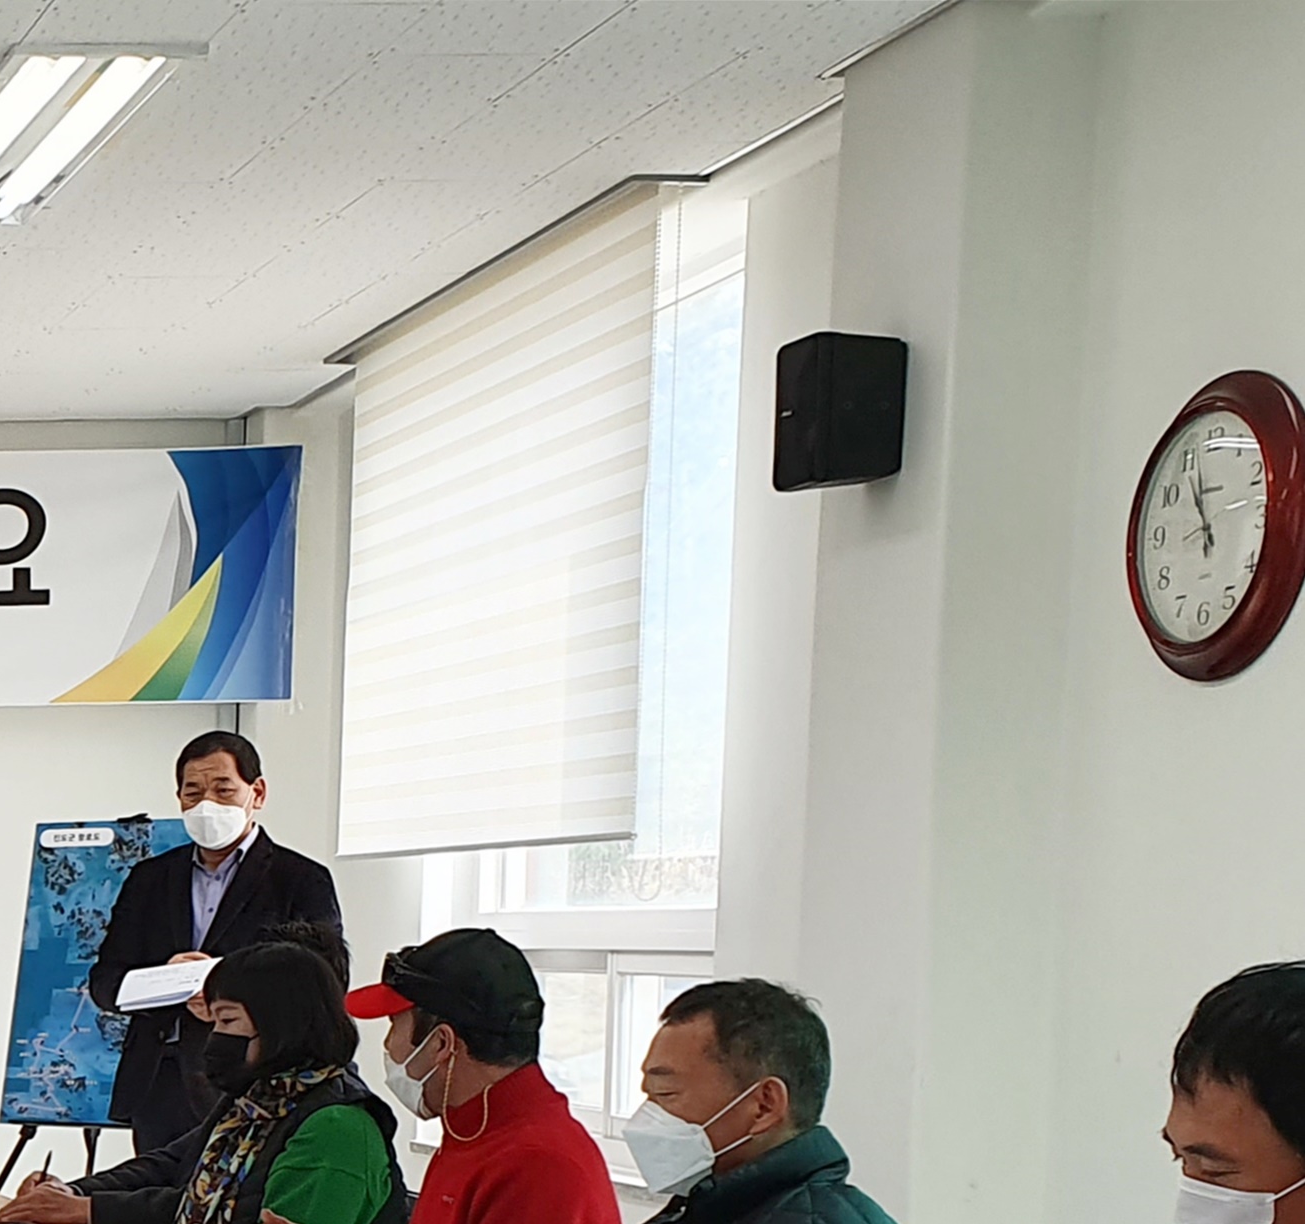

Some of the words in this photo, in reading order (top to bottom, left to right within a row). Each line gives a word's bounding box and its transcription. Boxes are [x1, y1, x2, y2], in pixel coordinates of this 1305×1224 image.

[1250, 460, 1263, 486] 2
[1160, 484, 1179, 509] 10
[1153, 525, 1166, 550] 9
[1157, 566, 1171, 590] 8
[1175, 595, 1187, 619] 7
[1222, 586, 1236, 610] 5
[1197, 601, 1210, 625] 6
